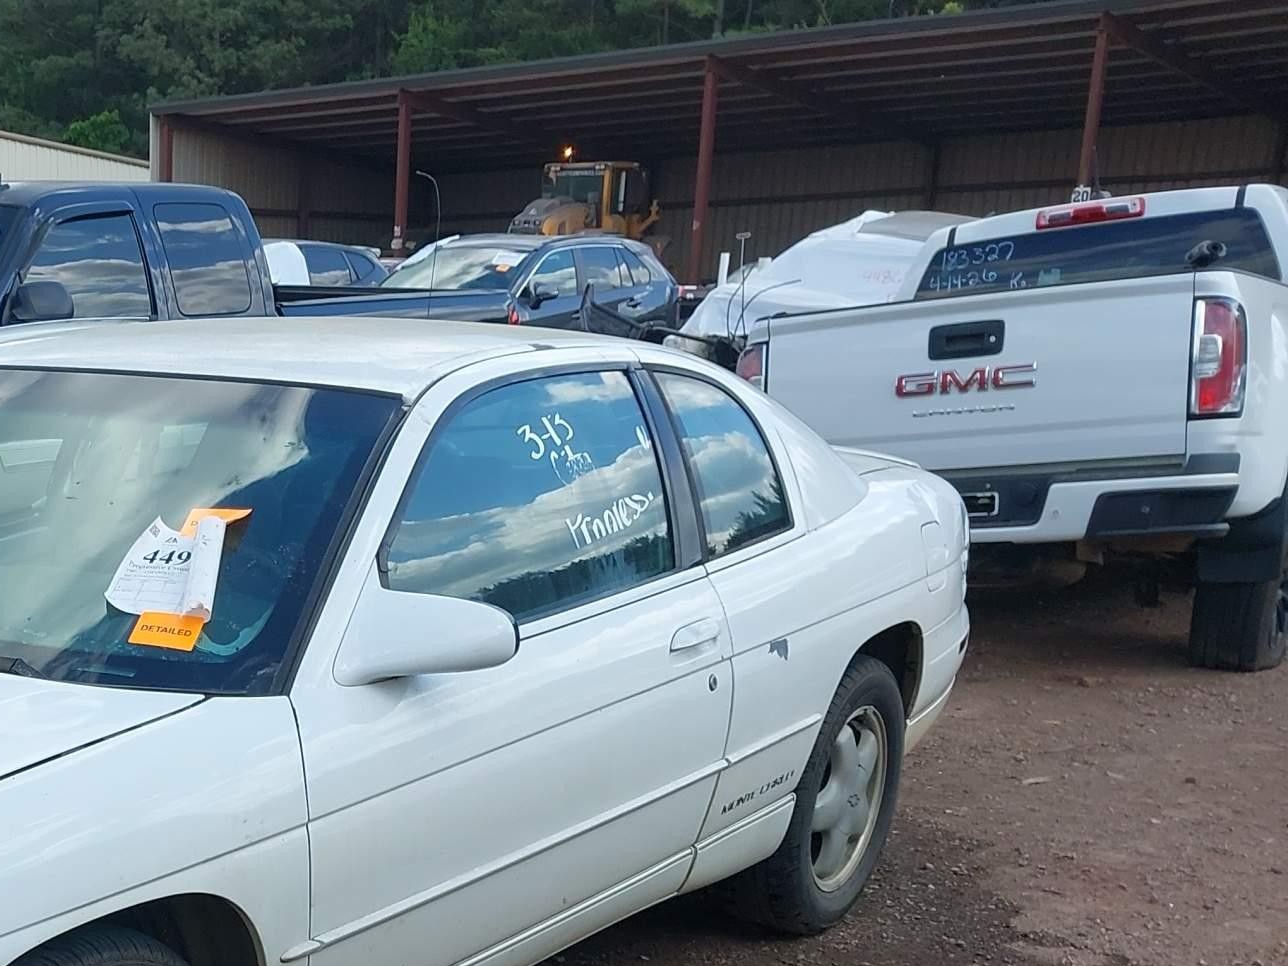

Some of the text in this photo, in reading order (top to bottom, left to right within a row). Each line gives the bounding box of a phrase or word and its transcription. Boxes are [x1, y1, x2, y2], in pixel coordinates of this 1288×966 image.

[1073, 190, 1089, 203] 20
[895, 361, 1037, 398] GMC
[143, 549, 192, 566] 449
[140, 624, 192, 637] DETAILED
